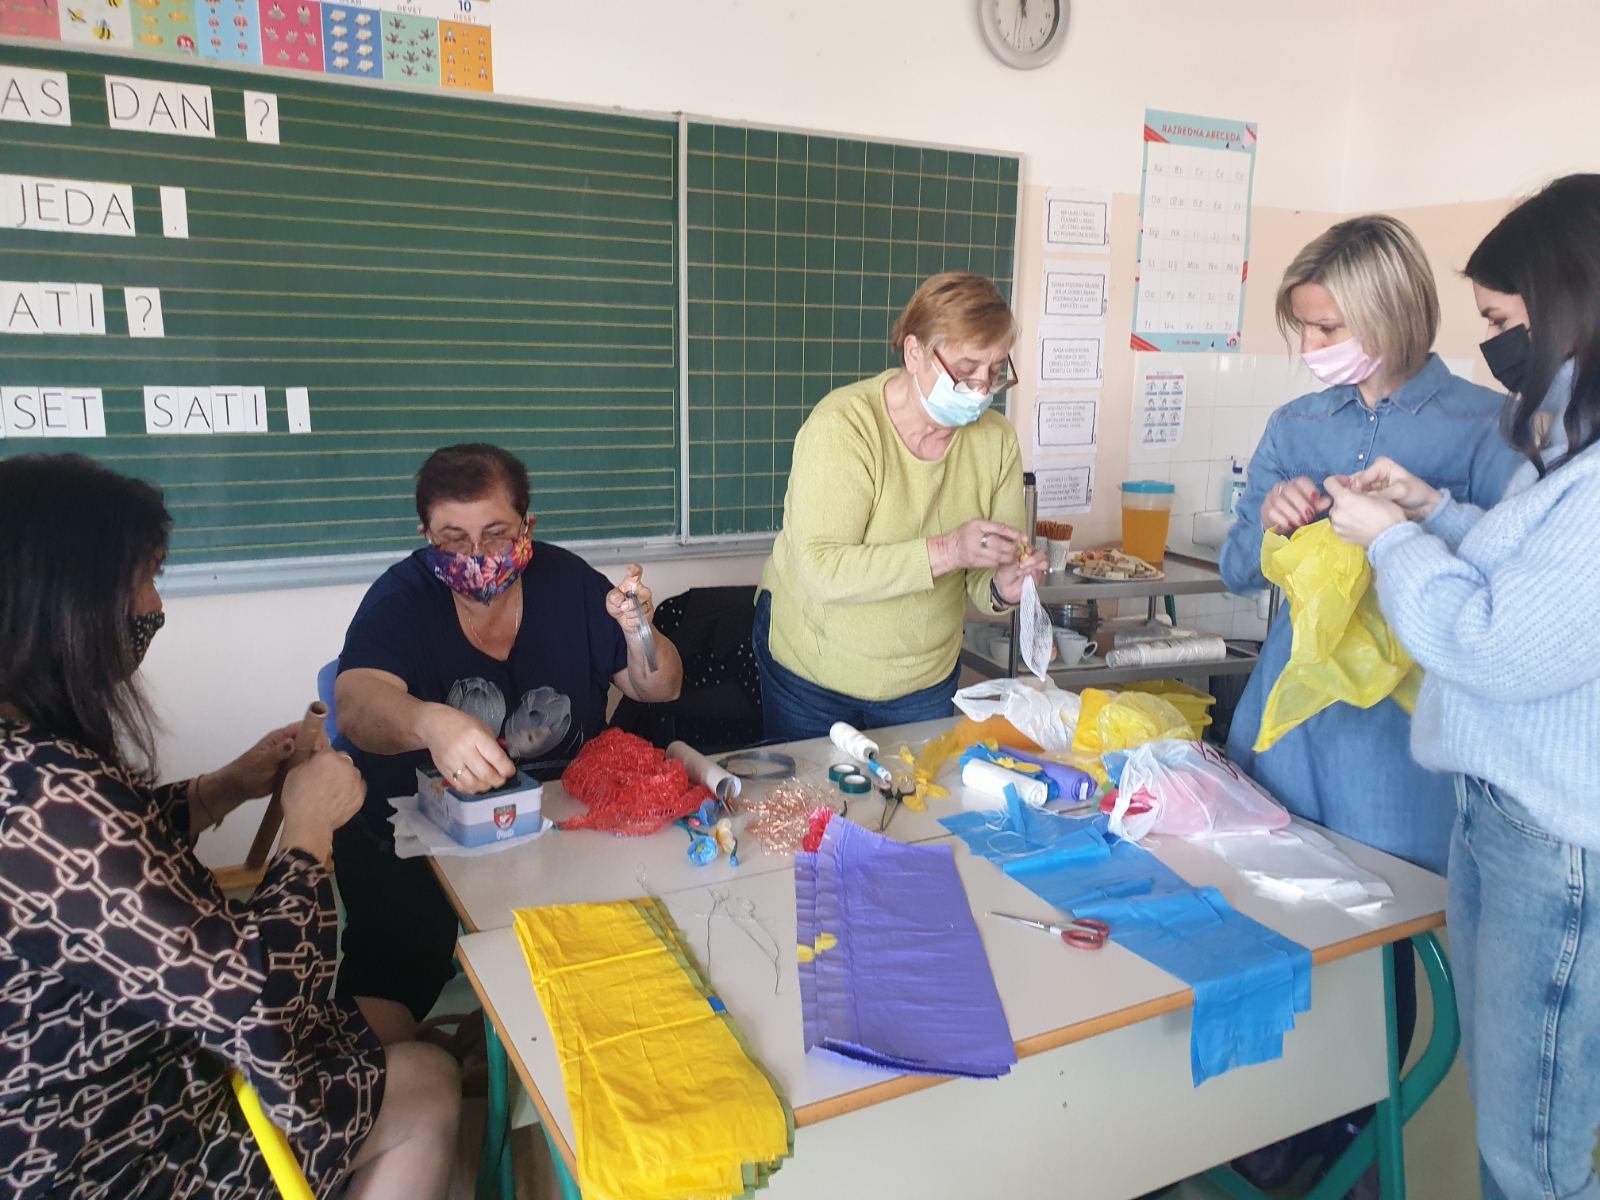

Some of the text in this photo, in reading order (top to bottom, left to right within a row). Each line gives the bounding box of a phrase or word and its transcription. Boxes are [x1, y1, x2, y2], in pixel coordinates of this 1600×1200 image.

[459, 0, 472, 13] 10
[1, 77, 270, 136] AS DAN ?
[1162, 123, 1241, 142] RAZREDNA ABECEDA
[16, 182, 132, 230] JEDA
[9, 290, 153, 332] ATI ?
[0, 392, 97, 432] SET
[153, 393, 259, 430] SATI
